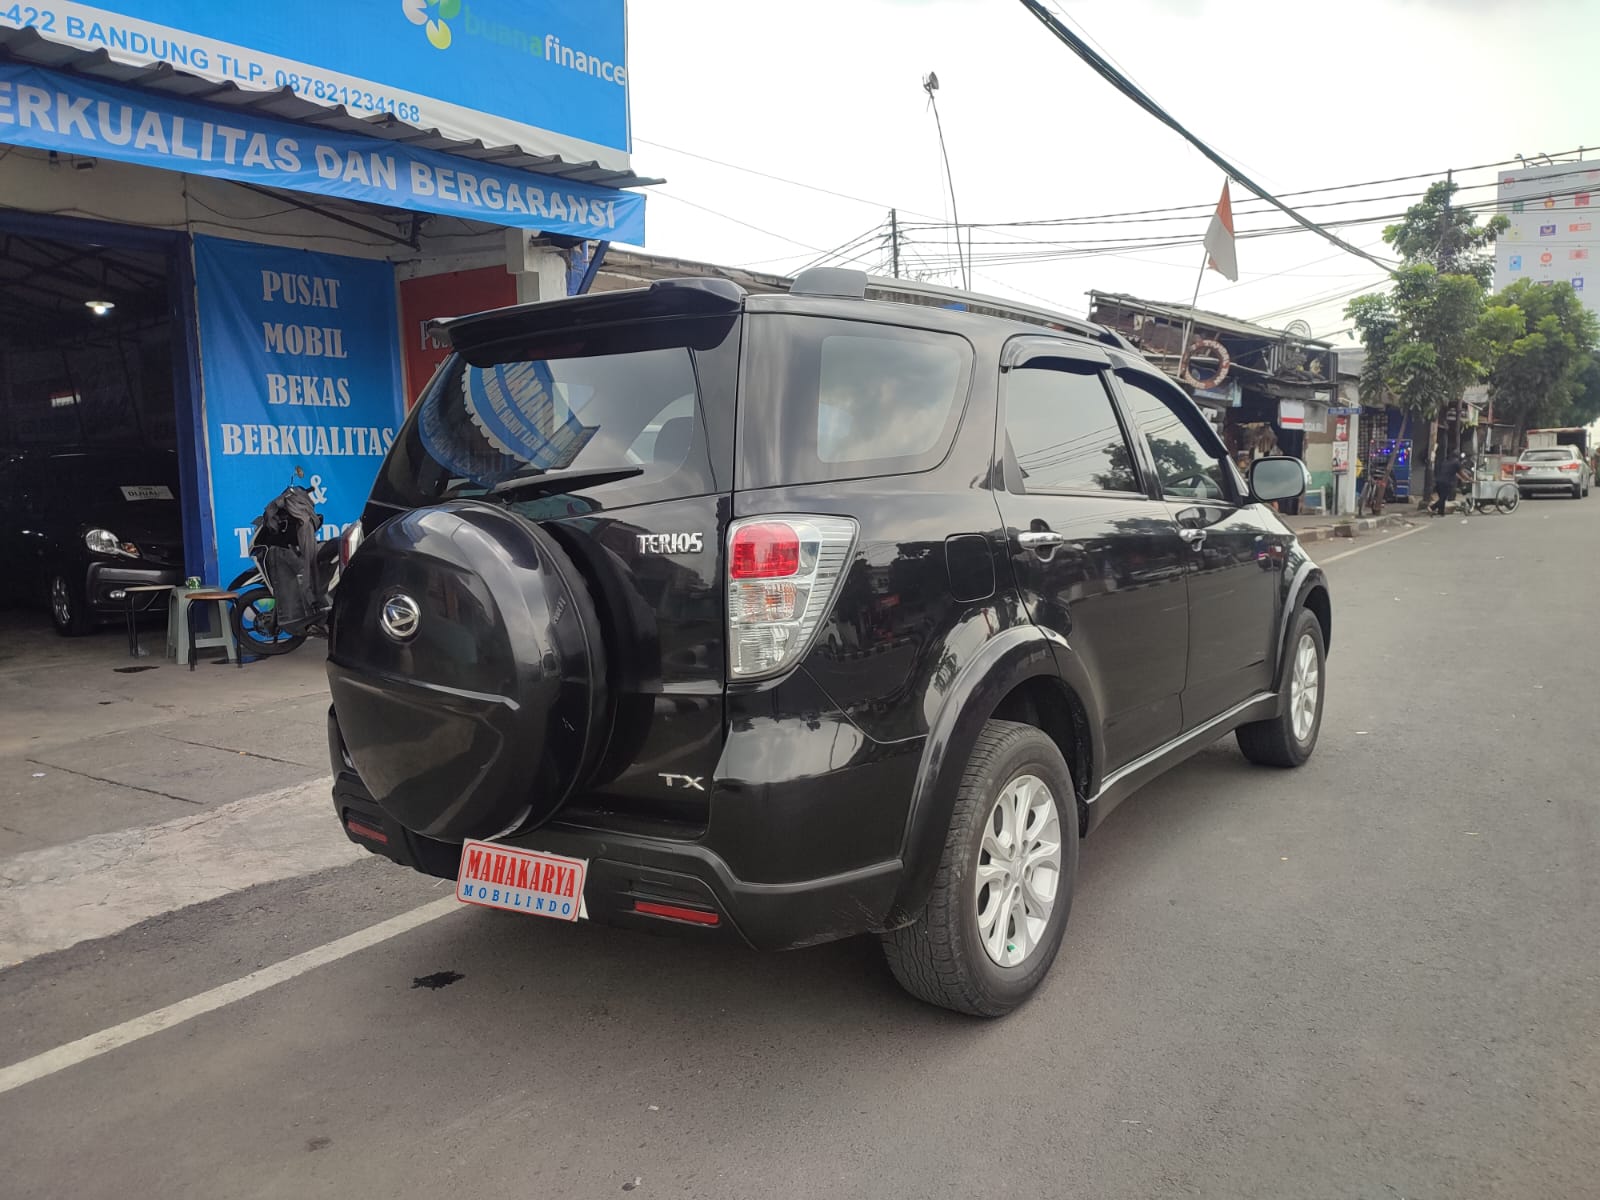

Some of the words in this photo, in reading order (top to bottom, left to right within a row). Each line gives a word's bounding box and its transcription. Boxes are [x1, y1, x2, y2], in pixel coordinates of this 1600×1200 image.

[66, 15, 209, 70] BANDUNG
[217, 54, 267, 86] TLP.
[275, 69, 420, 123] 087821234168
[314, 145, 397, 190] DAN
[410, 161, 616, 229] BERGARANSI
[261, 270, 340, 309] PUSAT
[263, 322, 347, 359] MOBIL
[266, 373, 351, 408] BEKAS
[221, 423, 394, 456] BERKUALITAS
[310, 474, 327, 504] &
[637, 532, 703, 554] TERIOS
[658, 773, 705, 791] TX
[465, 849, 575, 897] MAHAKARYA
[464, 884, 570, 915] MOBILINDO
